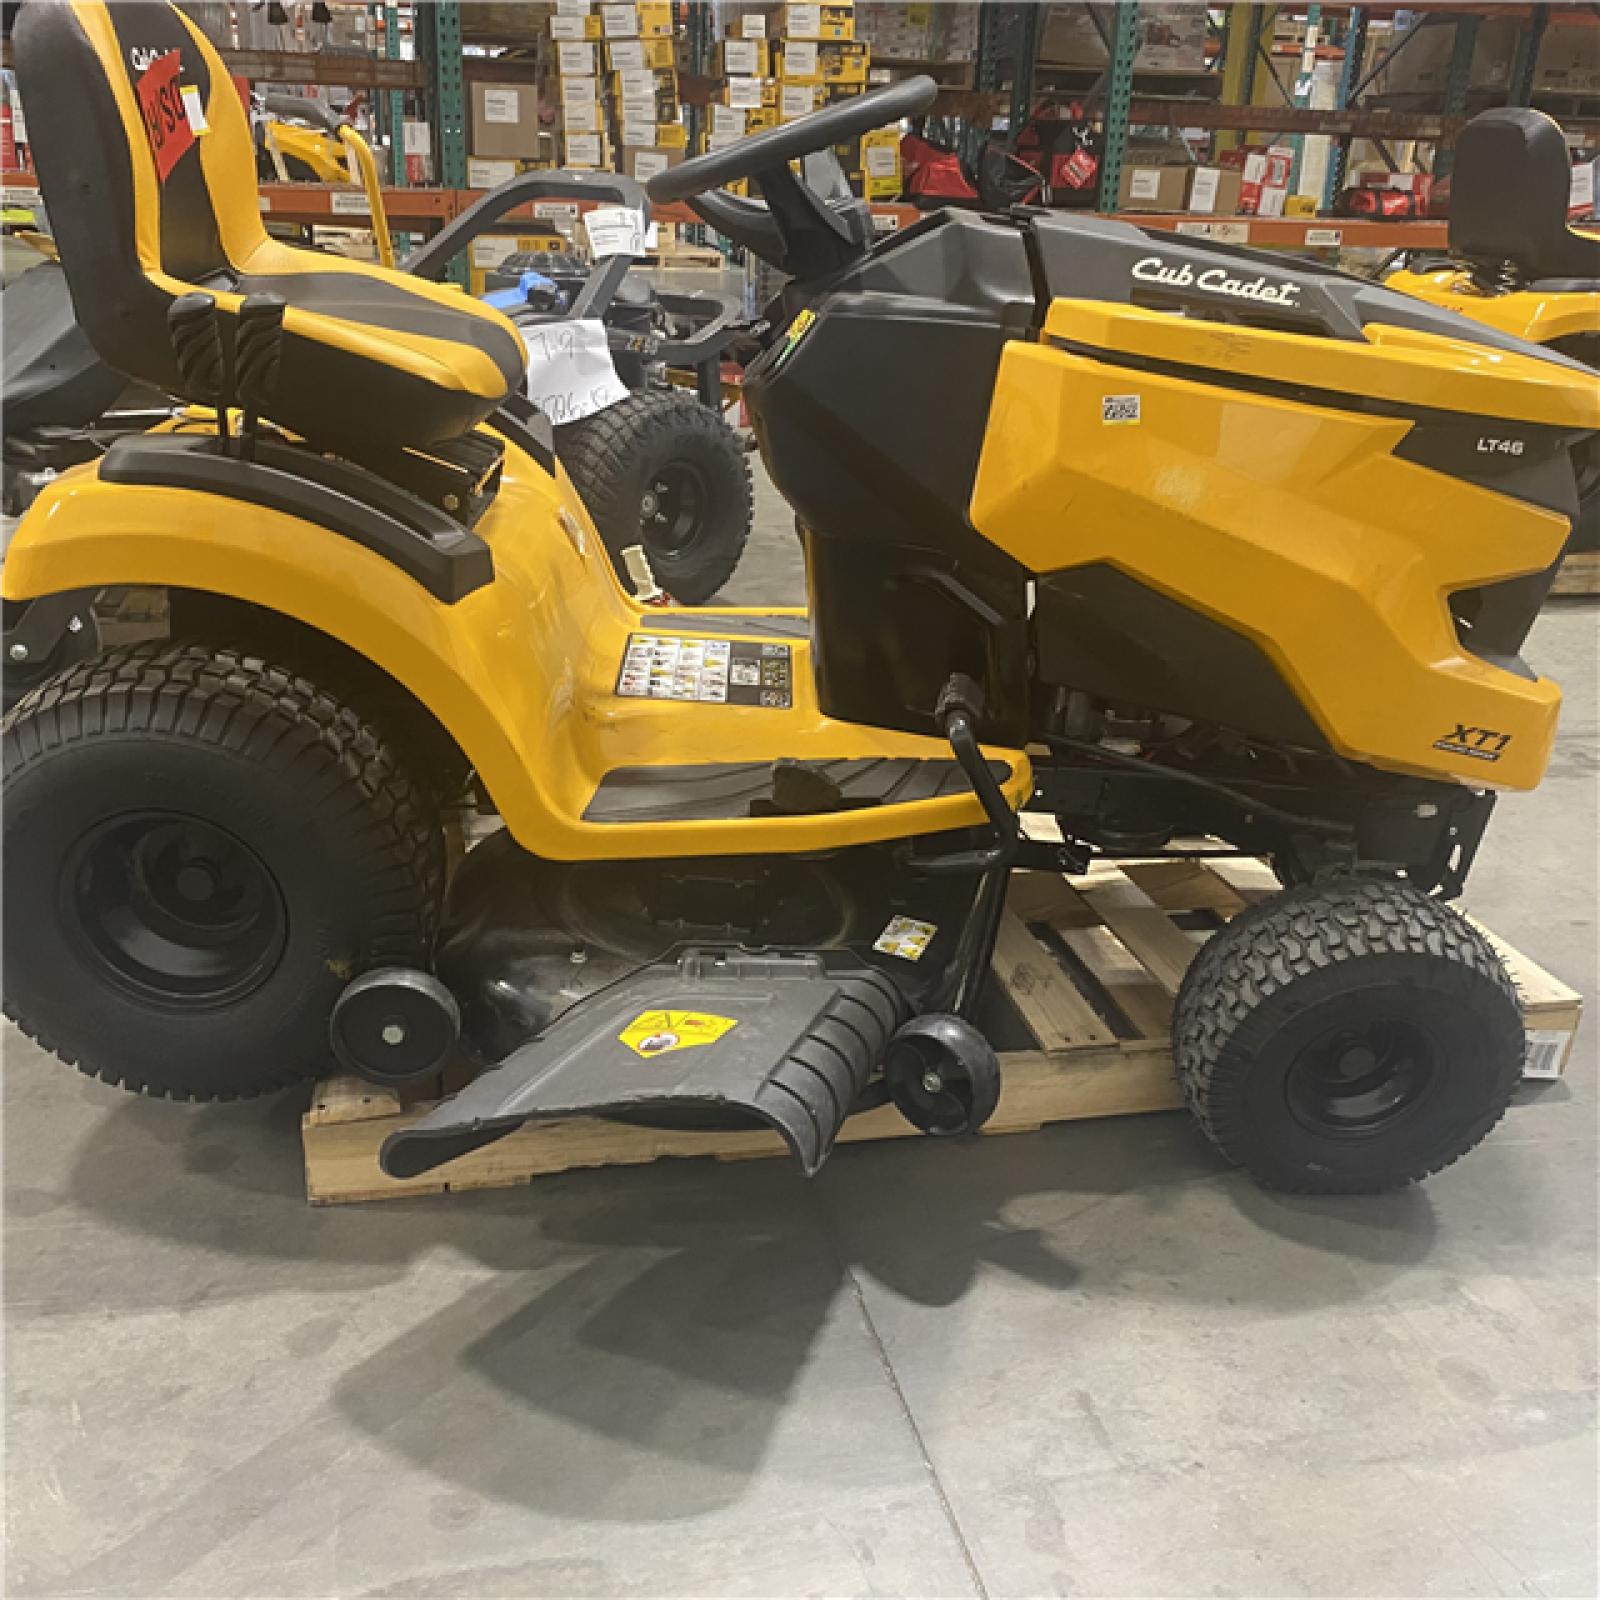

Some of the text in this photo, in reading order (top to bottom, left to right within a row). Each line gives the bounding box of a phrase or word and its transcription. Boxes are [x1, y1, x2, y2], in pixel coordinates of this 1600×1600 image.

[1131, 257, 1301, 306] Cub Cadet
[1476, 437, 1524, 456] LT46
[1438, 724, 1512, 752] XT1
